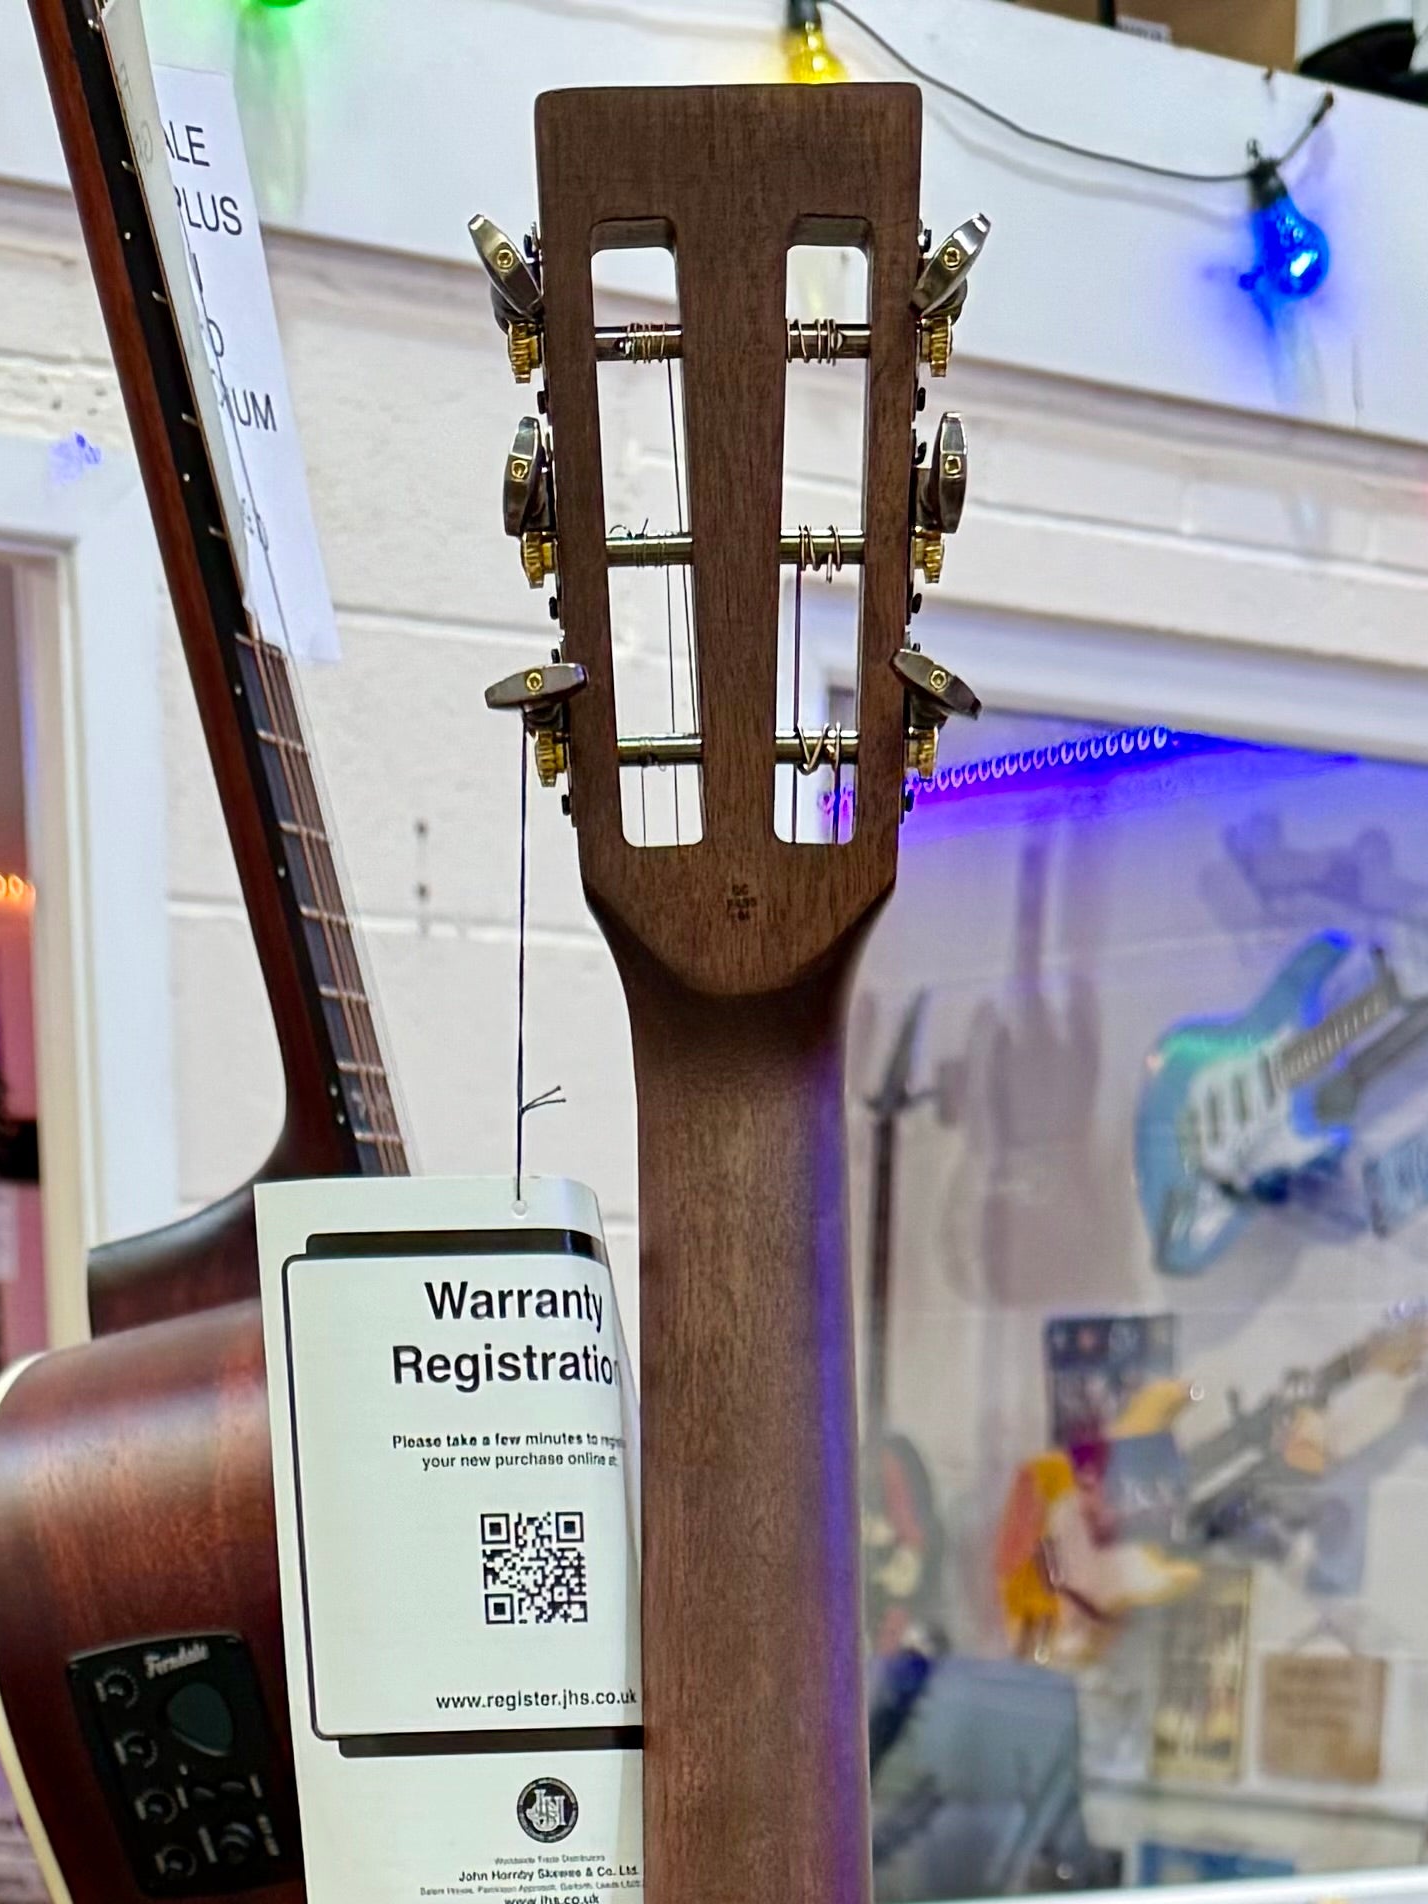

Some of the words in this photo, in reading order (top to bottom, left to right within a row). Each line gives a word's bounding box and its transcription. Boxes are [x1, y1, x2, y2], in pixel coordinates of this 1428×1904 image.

[425, 1281, 603, 1334] Warranty
[392, 1434, 442, 1449] Please
[446, 1432, 477, 1448] take
[482, 1436, 491, 1446] a
[495, 1432, 521, 1446] few
[525, 1431, 583, 1446] minutes
[586, 1432, 598, 1445] to
[422, 1456, 456, 1472] your
[460, 1455, 491, 1467] new
[495, 1452, 563, 1470] purchase
[567, 1451, 606, 1466] online
[436, 1688, 637, 1711] www.register.jhs.co.uk
[458, 1871, 488, 1882] John
